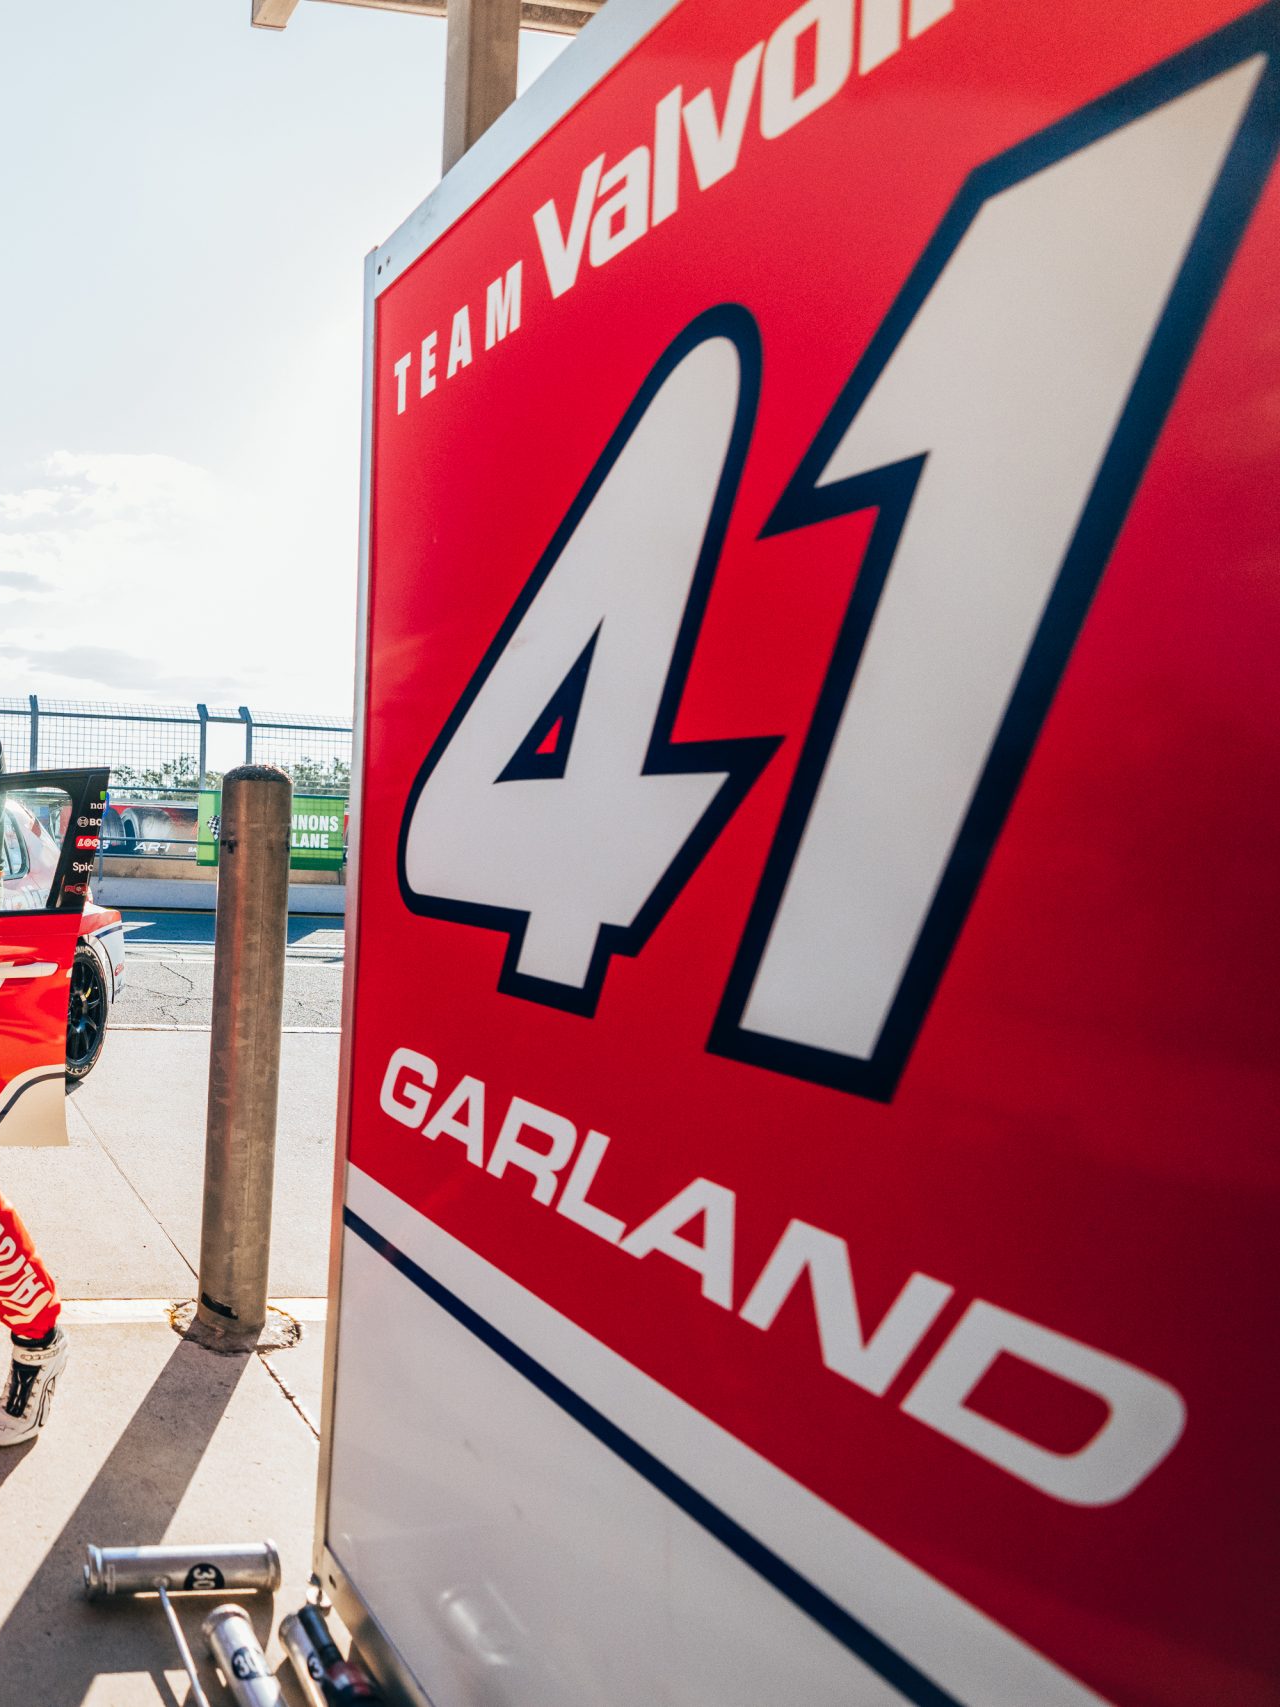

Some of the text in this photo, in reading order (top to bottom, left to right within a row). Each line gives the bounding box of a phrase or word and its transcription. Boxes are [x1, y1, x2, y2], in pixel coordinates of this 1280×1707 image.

[393, 0, 956, 415] TEAM Valvo
[397, 8, 1280, 1103] 41
[291, 833, 329, 849] LANE
[379, 1047, 1187, 1507] GARLAND
[192, 1567, 217, 1589] 30
